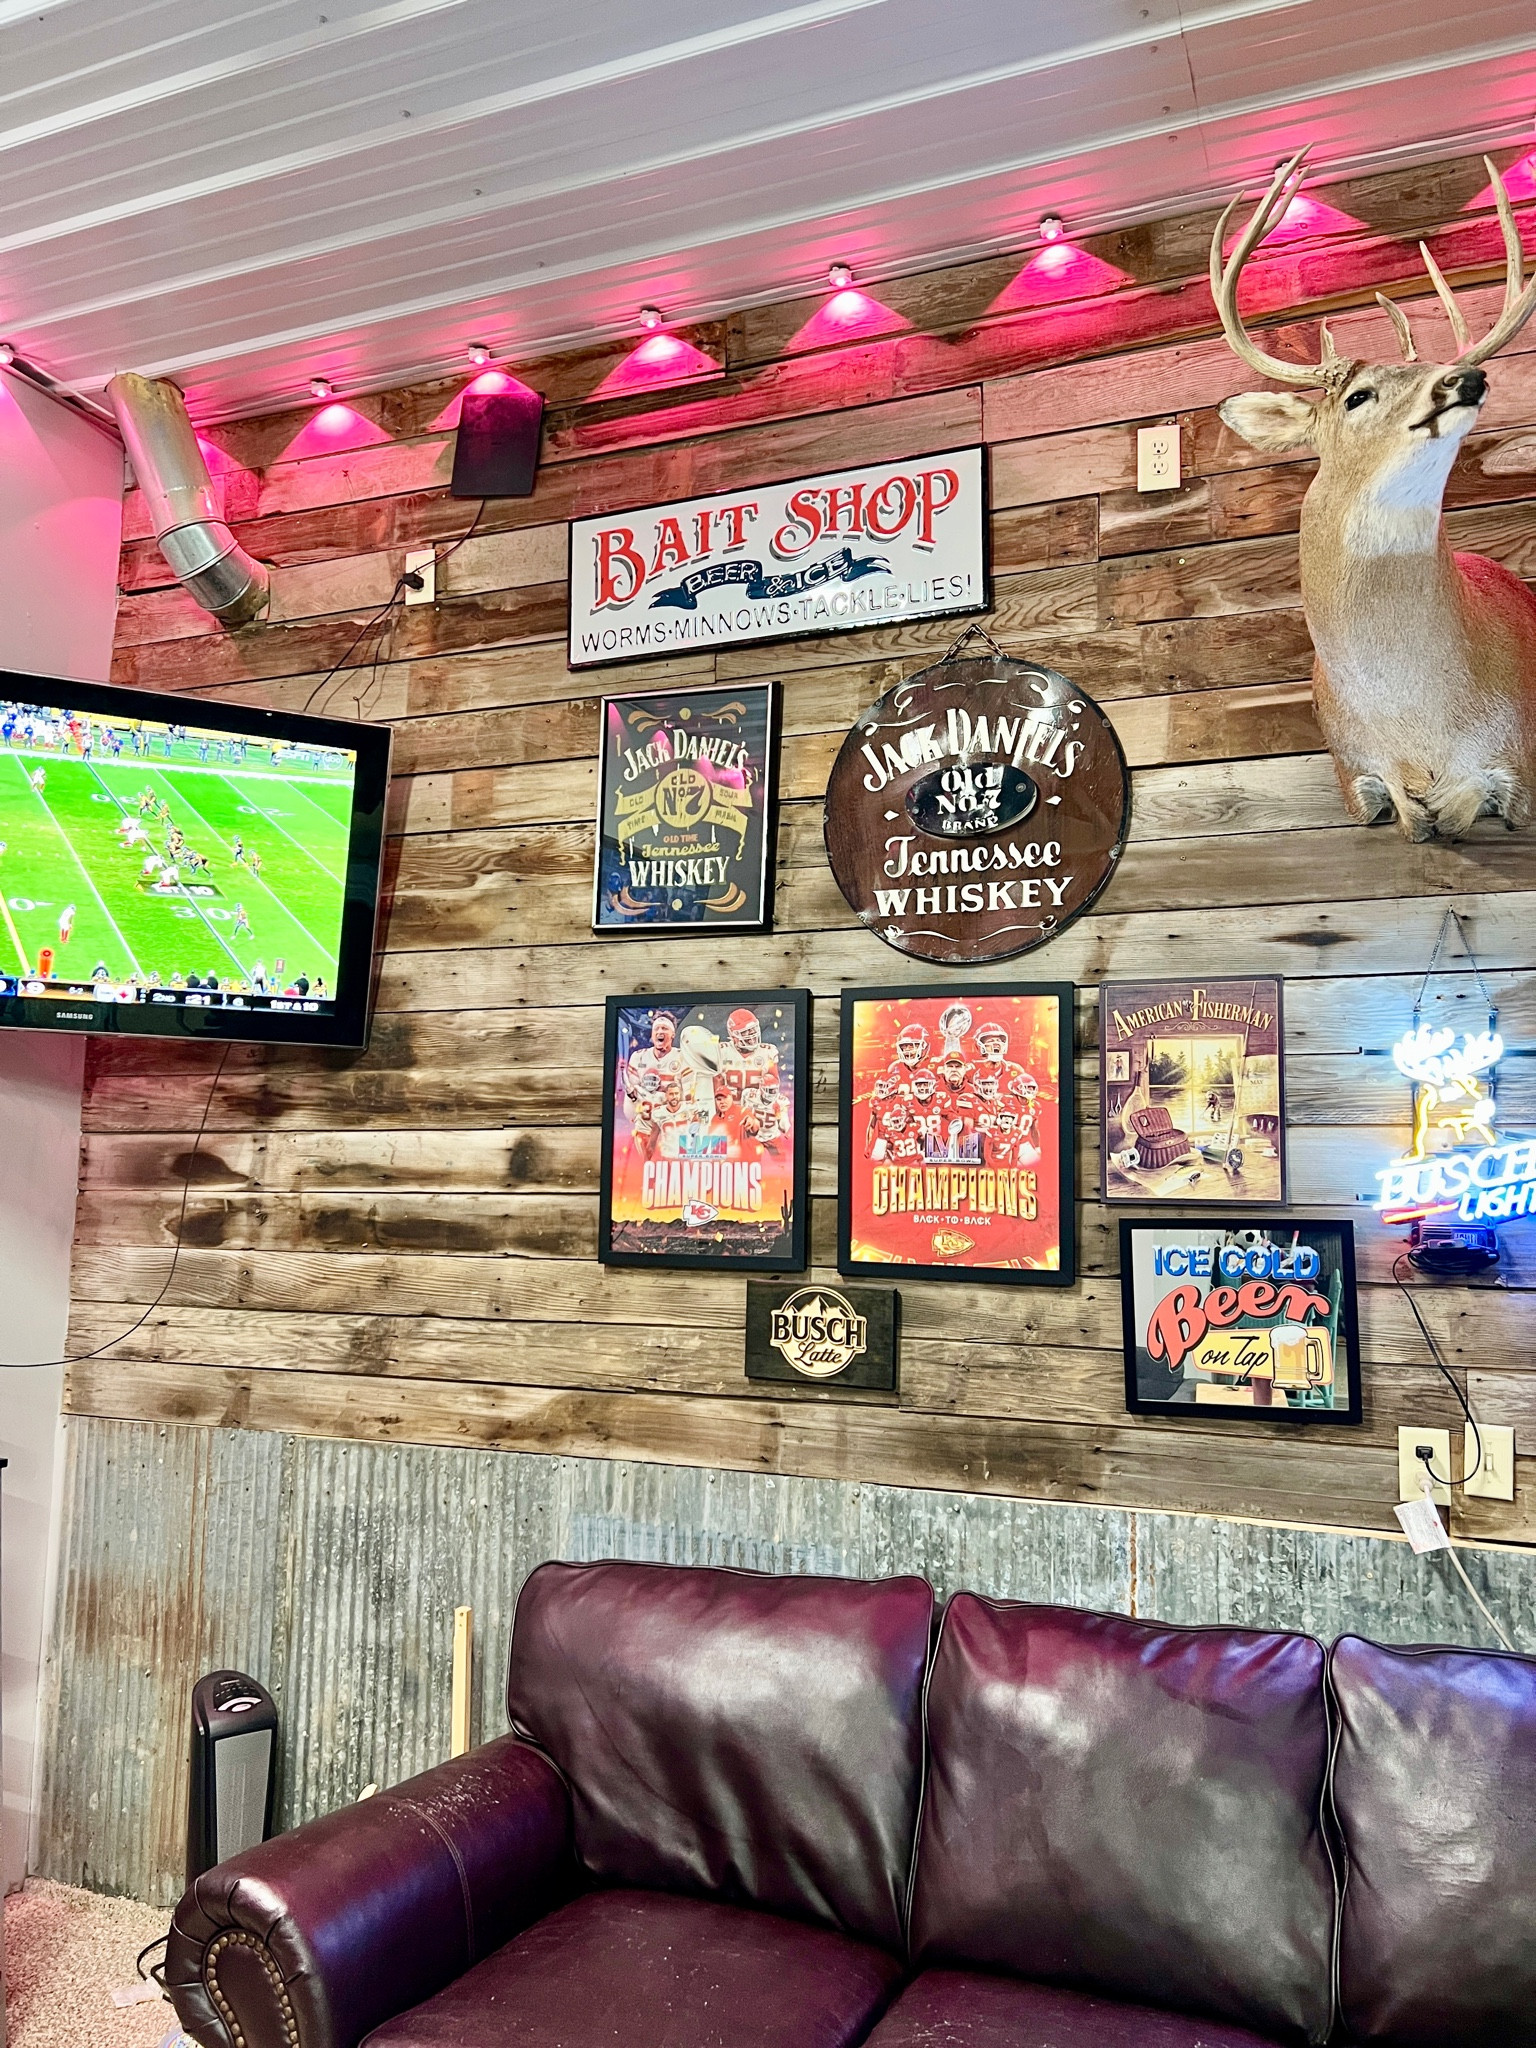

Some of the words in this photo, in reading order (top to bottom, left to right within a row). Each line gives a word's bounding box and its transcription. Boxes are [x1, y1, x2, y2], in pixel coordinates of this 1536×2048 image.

[590, 502, 759, 615] BAIT
[769, 469, 960, 562] SHOP
[686, 562, 760, 595] BEER
[766, 575, 795, 597] &
[796, 555, 850, 590] ICE
[623, 739, 671, 782] JACK
[860, 722, 946, 793] JACK
[941, 767, 999, 792] Old
[663, 835, 679, 843] OLD
[681, 834, 698, 842] TIME
[942, 815, 999, 833] BRAND
[641, 842, 720, 858] Tennessee
[883, 836, 1061, 878] Tennessee
[629, 856, 730, 887] WHISKEY
[873, 876, 1074, 917] WHISKEY
[56, 1012, 94, 1020] SAMSUNG
[1112, 1000, 1184, 1042] AMERICAN
[1191, 989, 1274, 1032] FISHERMAN
[894, 1138, 917, 1158] 32
[641, 1160, 763, 1212] CHAMPIONS
[872, 1166, 1037, 1221] CHAMPIONS
[1152, 1244, 1212, 1277] ICE
[1219, 1245, 1321, 1281] COLD
[773, 1313, 863, 1347] BUSCH
[1147, 1280, 1331, 1373] Beer
[794, 1341, 843, 1368] Latte
[1200, 1347, 1231, 1366] on
[1230, 1335, 1269, 1382] Tap
